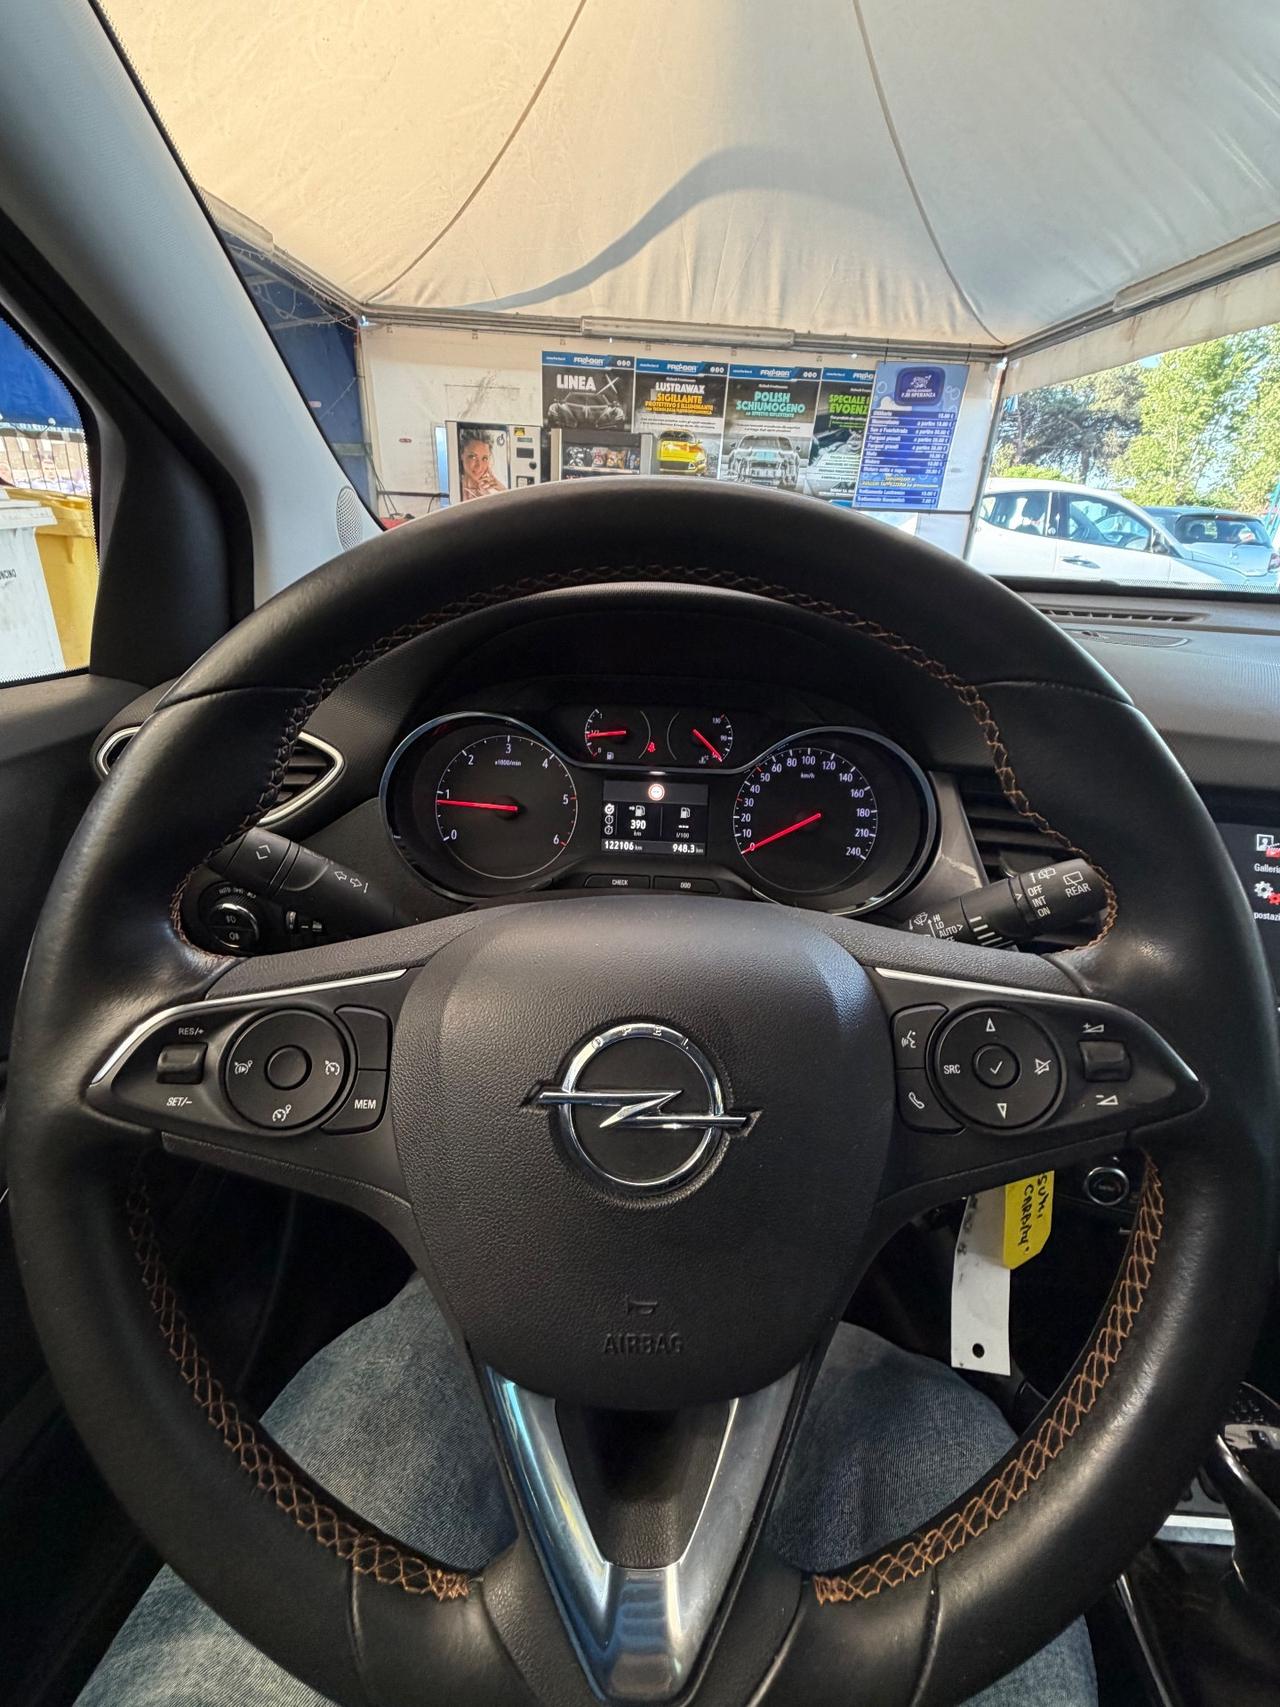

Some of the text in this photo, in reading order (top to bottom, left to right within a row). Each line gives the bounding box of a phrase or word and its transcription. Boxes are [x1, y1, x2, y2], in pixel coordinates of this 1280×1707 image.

[556, 374, 596, 391] LINEA
[655, 382, 705, 394] LUSTRAWAX
[656, 392, 703, 404] SIGILLANTE
[754, 391, 791, 403] POLISH
[829, 394, 866, 404] SPECIALE
[736, 400, 806, 413] SCHIUMOGENO
[506, 744, 512, 754] 3
[468, 755, 474, 765] 2
[542, 758, 549, 768] 4
[786, 758, 797, 767] 80
[801, 756, 816, 765] 100
[771, 763, 782, 772] 60
[822, 761, 836, 770] 120
[760, 773, 770, 782] 50
[839, 773, 853, 782] 140
[446, 789, 450, 799] 1
[750, 785, 760, 793] 40
[851, 789, 864, 798] 160
[563, 794, 569, 805] 5
[744, 798, 754, 807] 30
[741, 813, 751, 822] 20
[856, 808, 870, 817] 180
[630, 820, 646, 829] 390
[451, 829, 457, 840] 0
[742, 829, 752, 837] 10
[855, 828, 869, 837] 210
[553, 834, 559, 844] 6
[604, 840, 634, 850] 122106
[672, 843, 695, 853] 948.3
[846, 847, 861, 856] 240
[1027, 885, 1043, 897] OFF
[1064, 882, 1092, 898] REAR
[1032, 896, 1047, 908] INT
[1037, 907, 1051, 918] ON
[933, 914, 941, 923] HI
[938, 925, 957, 938] AUTO
[178, 1027, 204, 1036] RES/+
[943, 1064, 961, 1075] SRC
[354, 1099, 377, 1110] MEM
[603, 1332, 683, 1354] AIRBAG
